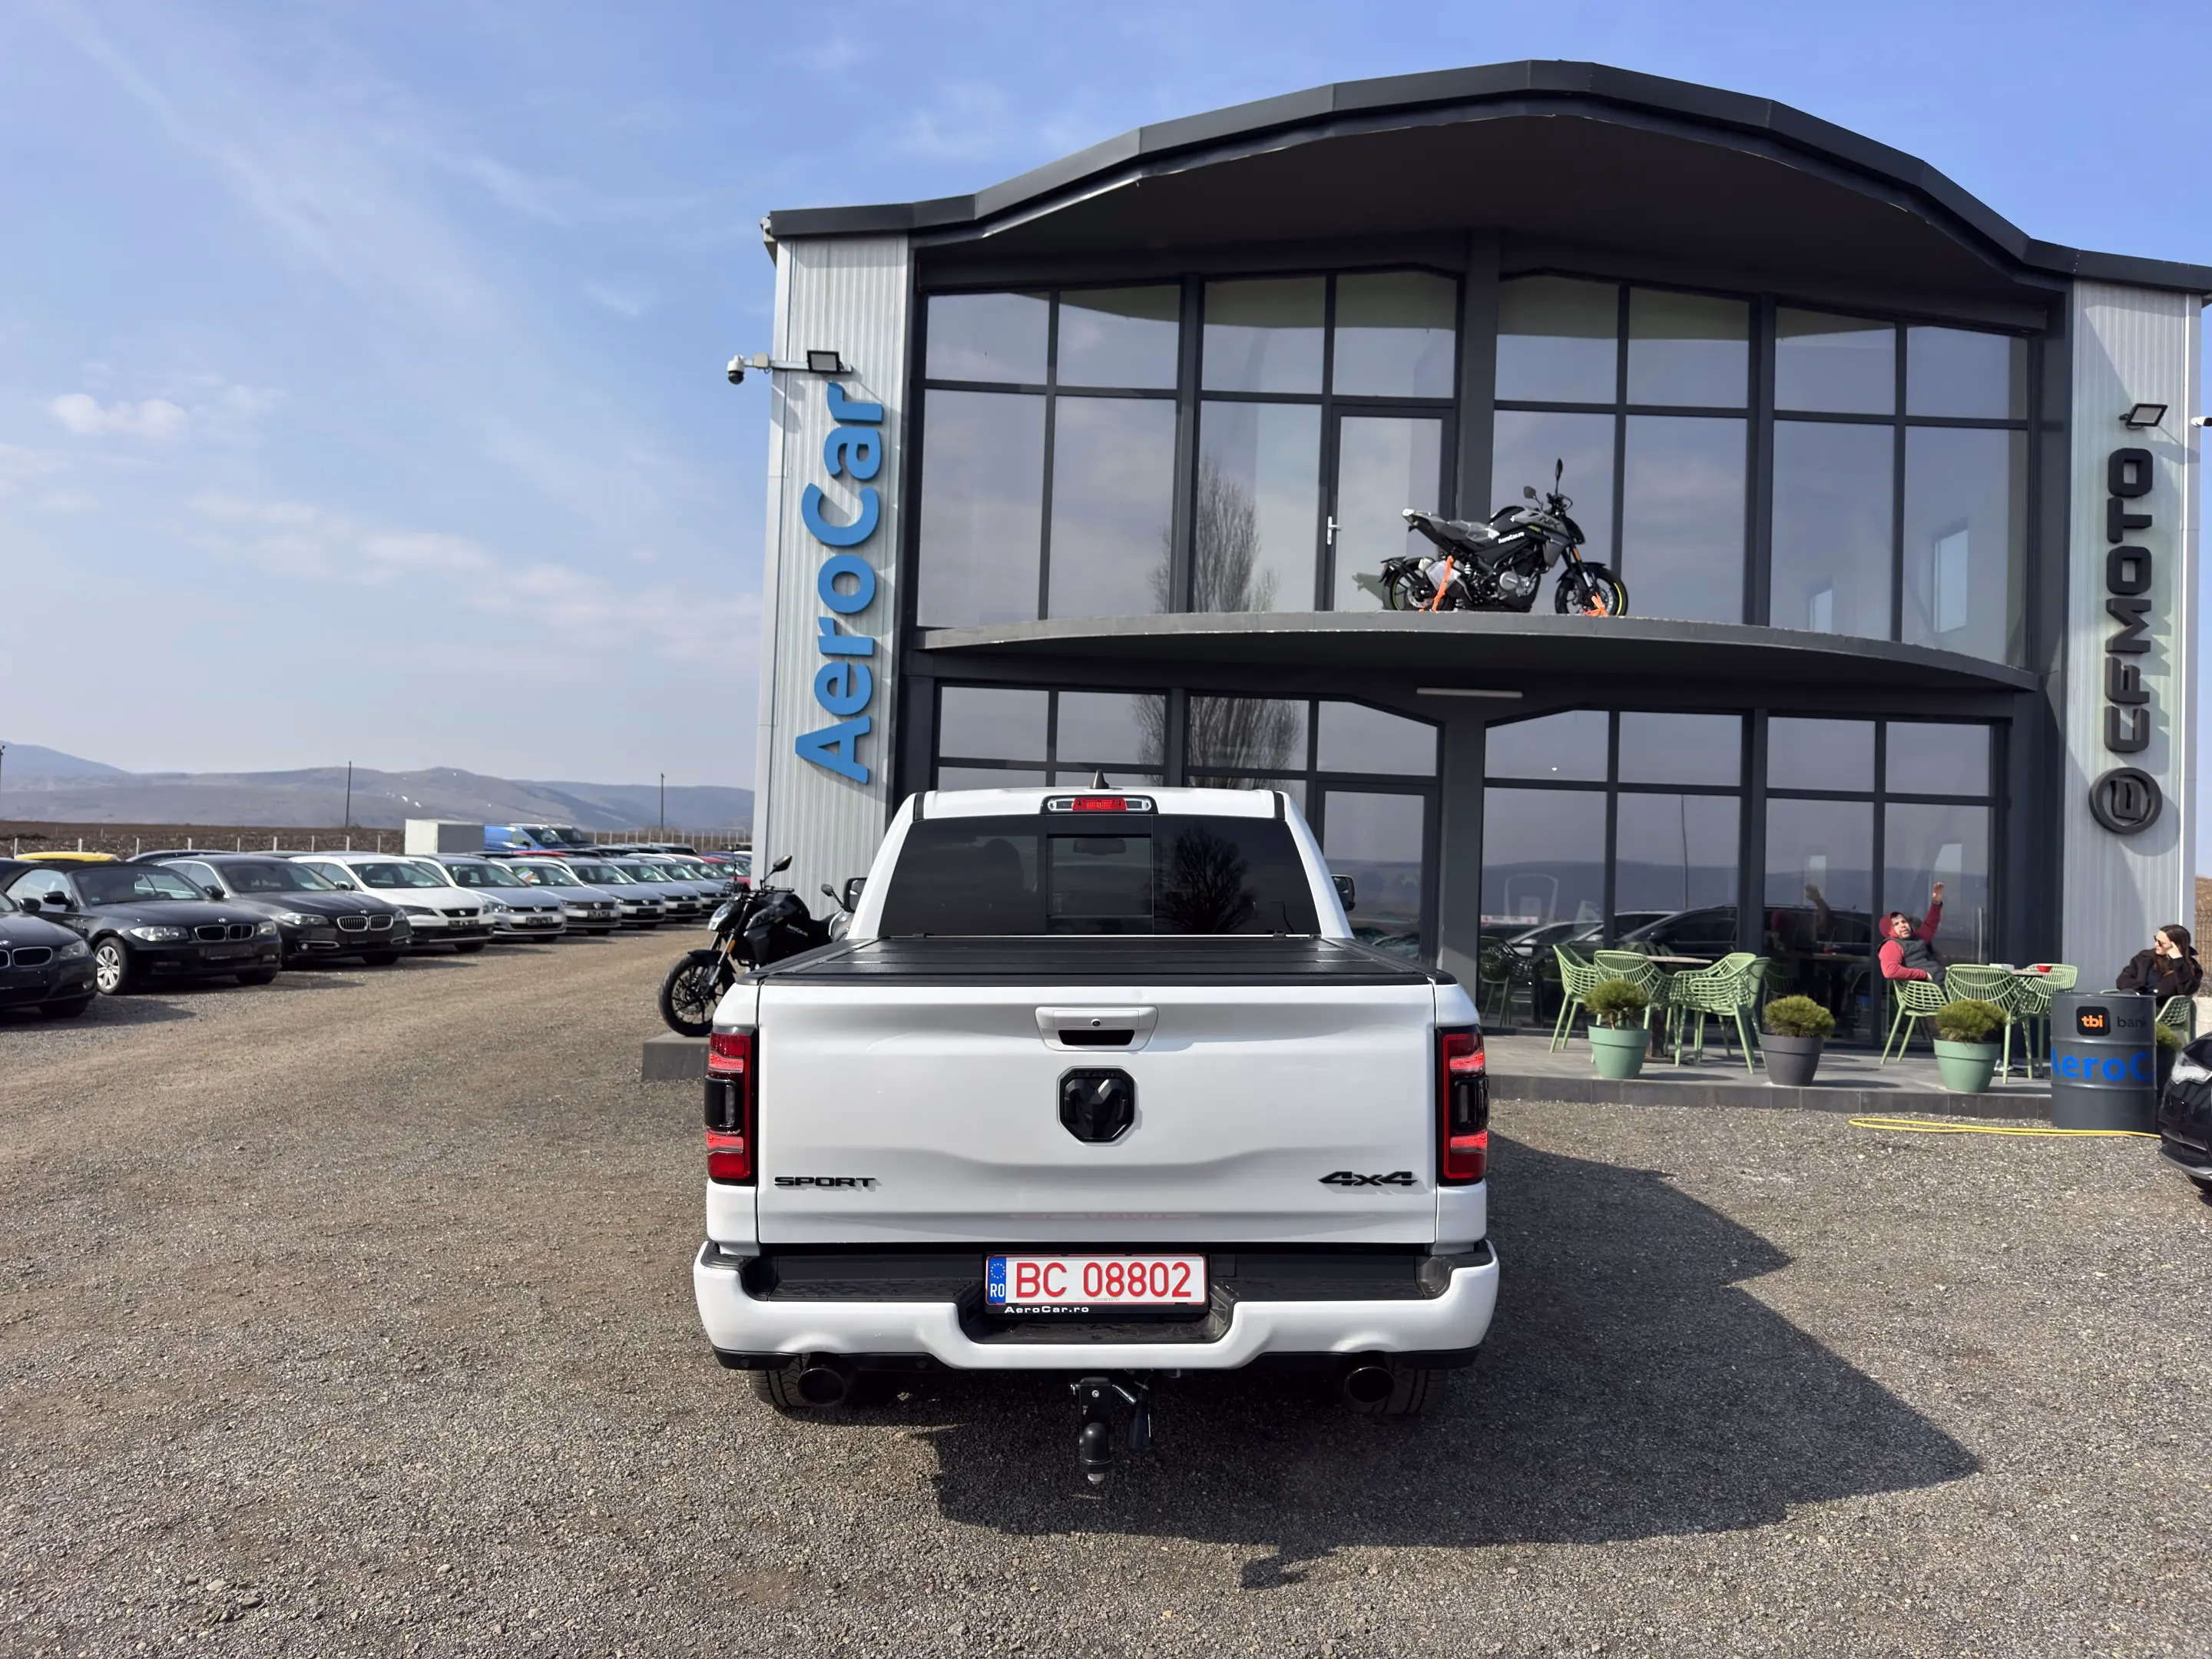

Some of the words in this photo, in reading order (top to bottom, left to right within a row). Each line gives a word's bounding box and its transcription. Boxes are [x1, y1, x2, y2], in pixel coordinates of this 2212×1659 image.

[795, 381, 884, 785] AeroCar
[2104, 447, 2154, 753] CFMOTO
[2081, 1015, 2103, 1028] tbi
[774, 1176, 876, 1187] SPORT
[1318, 1171, 1418, 1186] 4x4
[1016, 1262, 1067, 1298] BC
[1083, 1262, 1191, 1297] 08802
[990, 1283, 1005, 1297] RO
